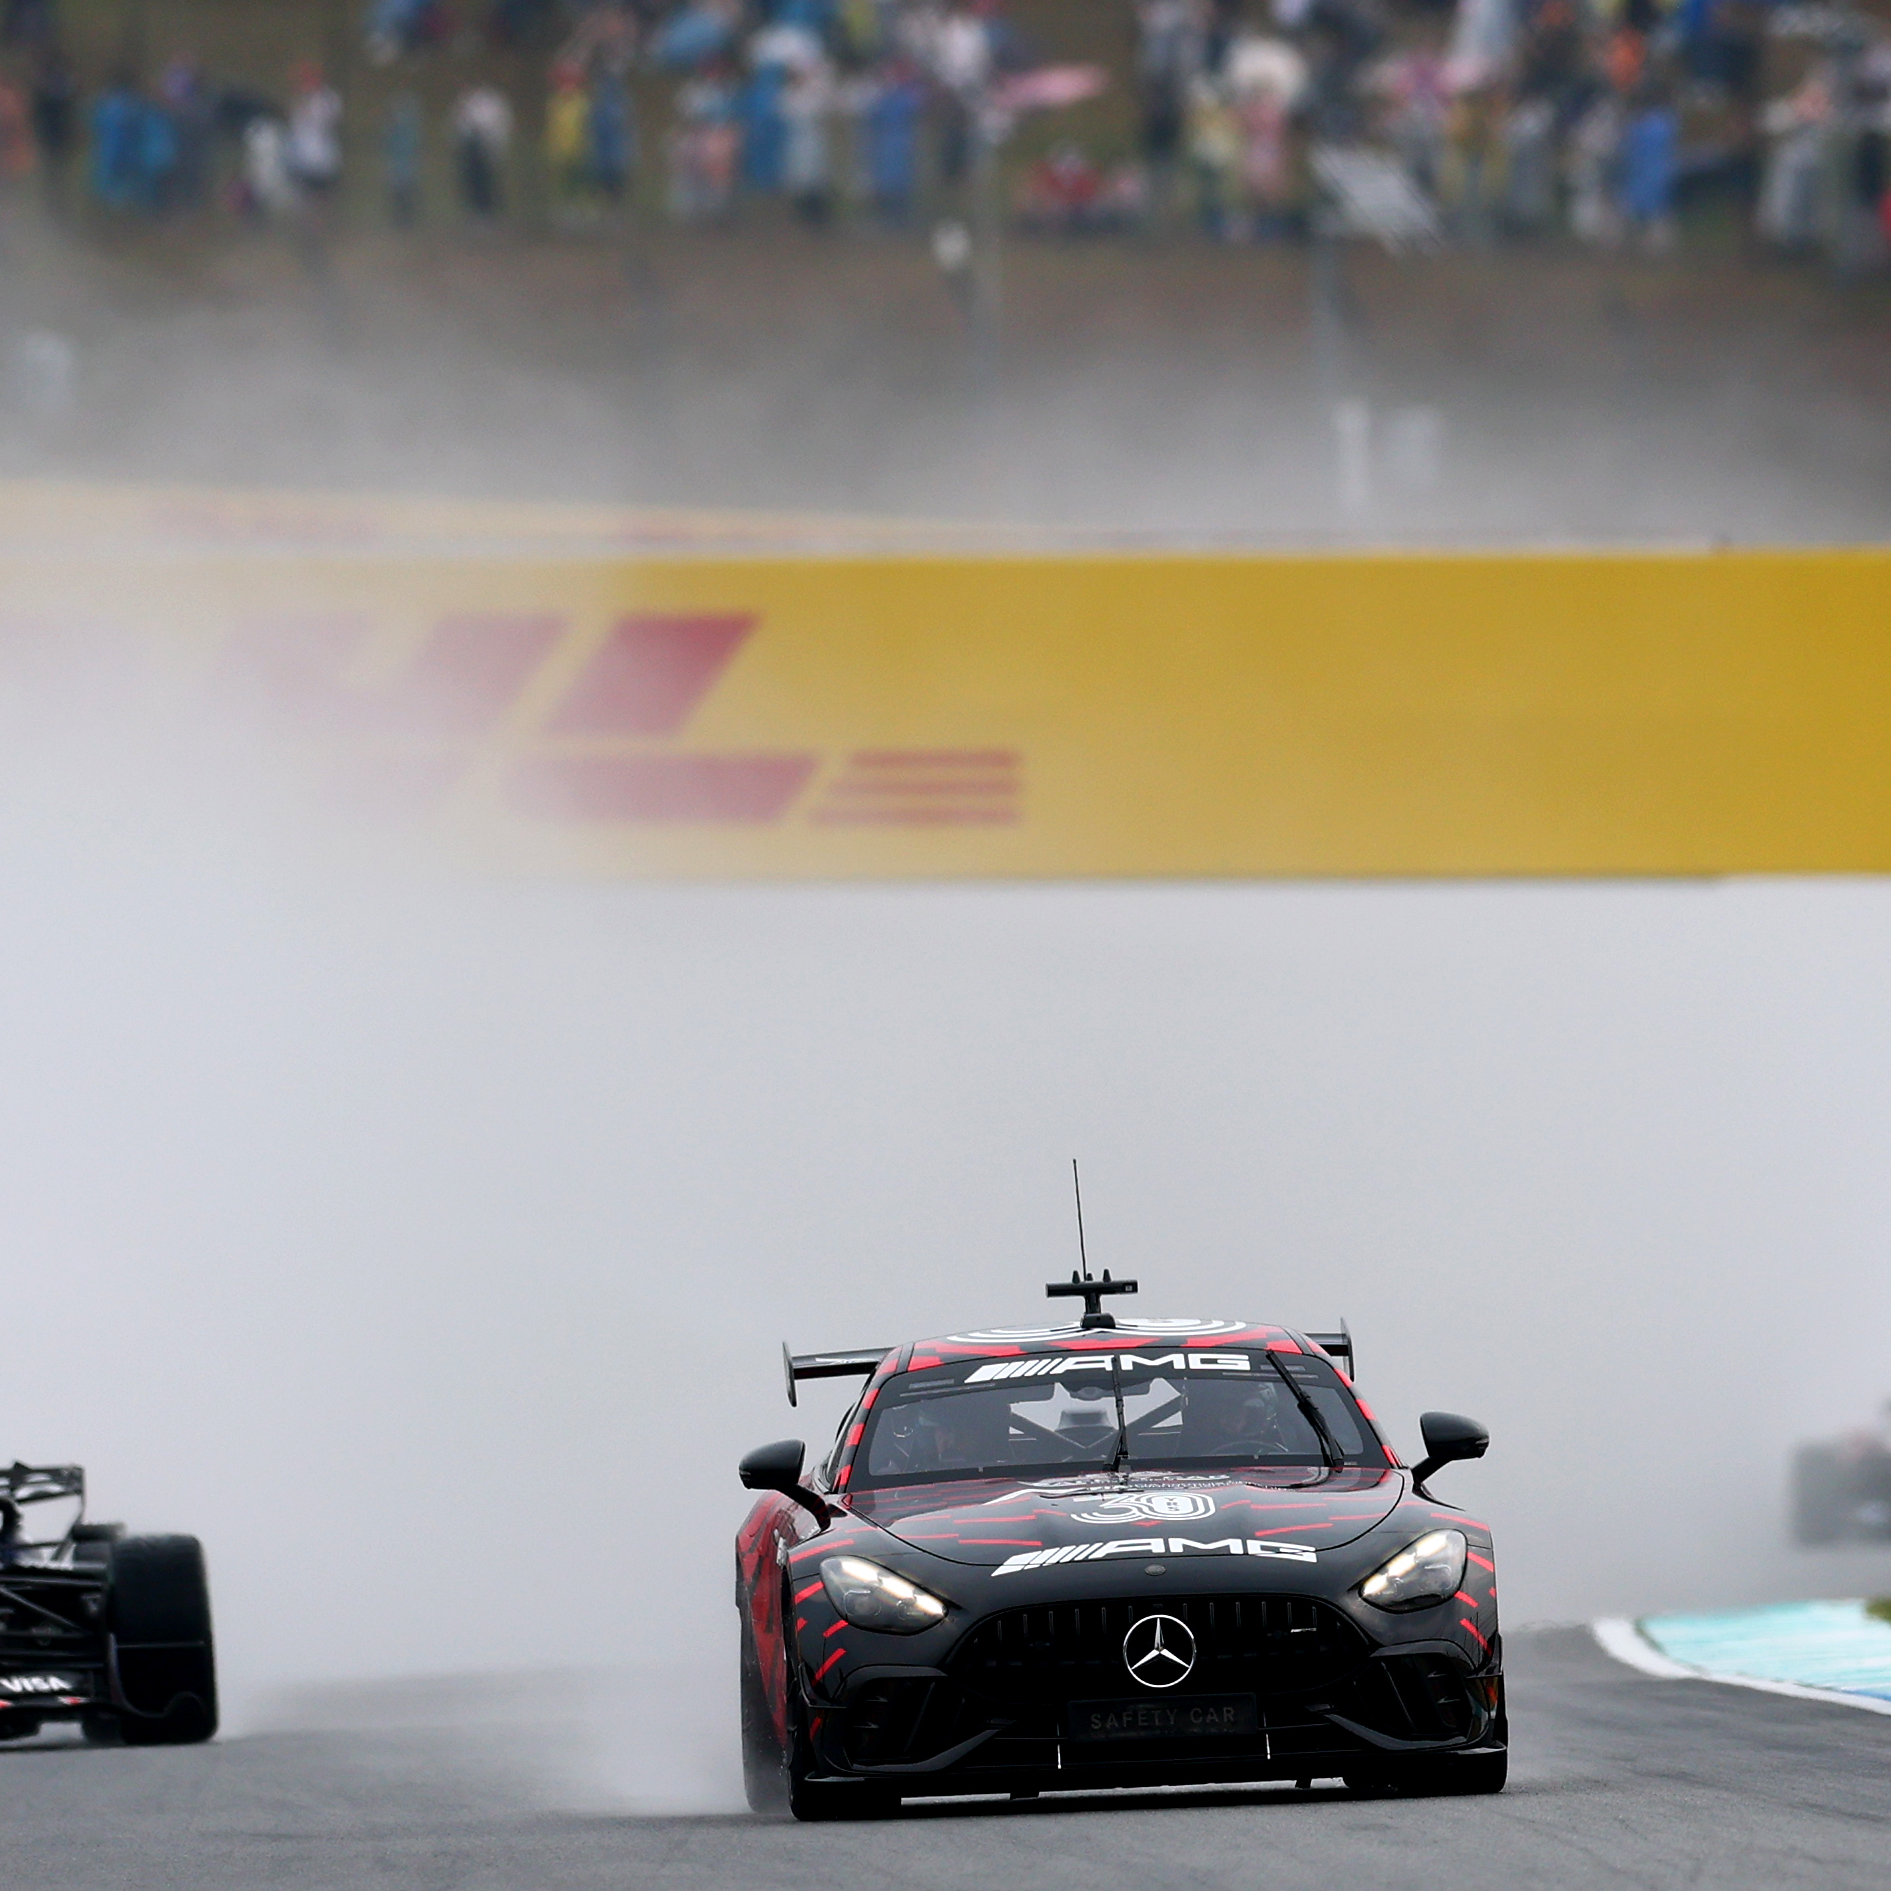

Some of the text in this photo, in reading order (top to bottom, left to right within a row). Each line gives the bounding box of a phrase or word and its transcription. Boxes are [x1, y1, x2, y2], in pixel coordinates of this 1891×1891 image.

[1050, 1353, 1251, 1374] AMG
[1094, 1537, 1317, 1563] AMG
[1091, 1707, 1236, 1730] SAFETY CAR
